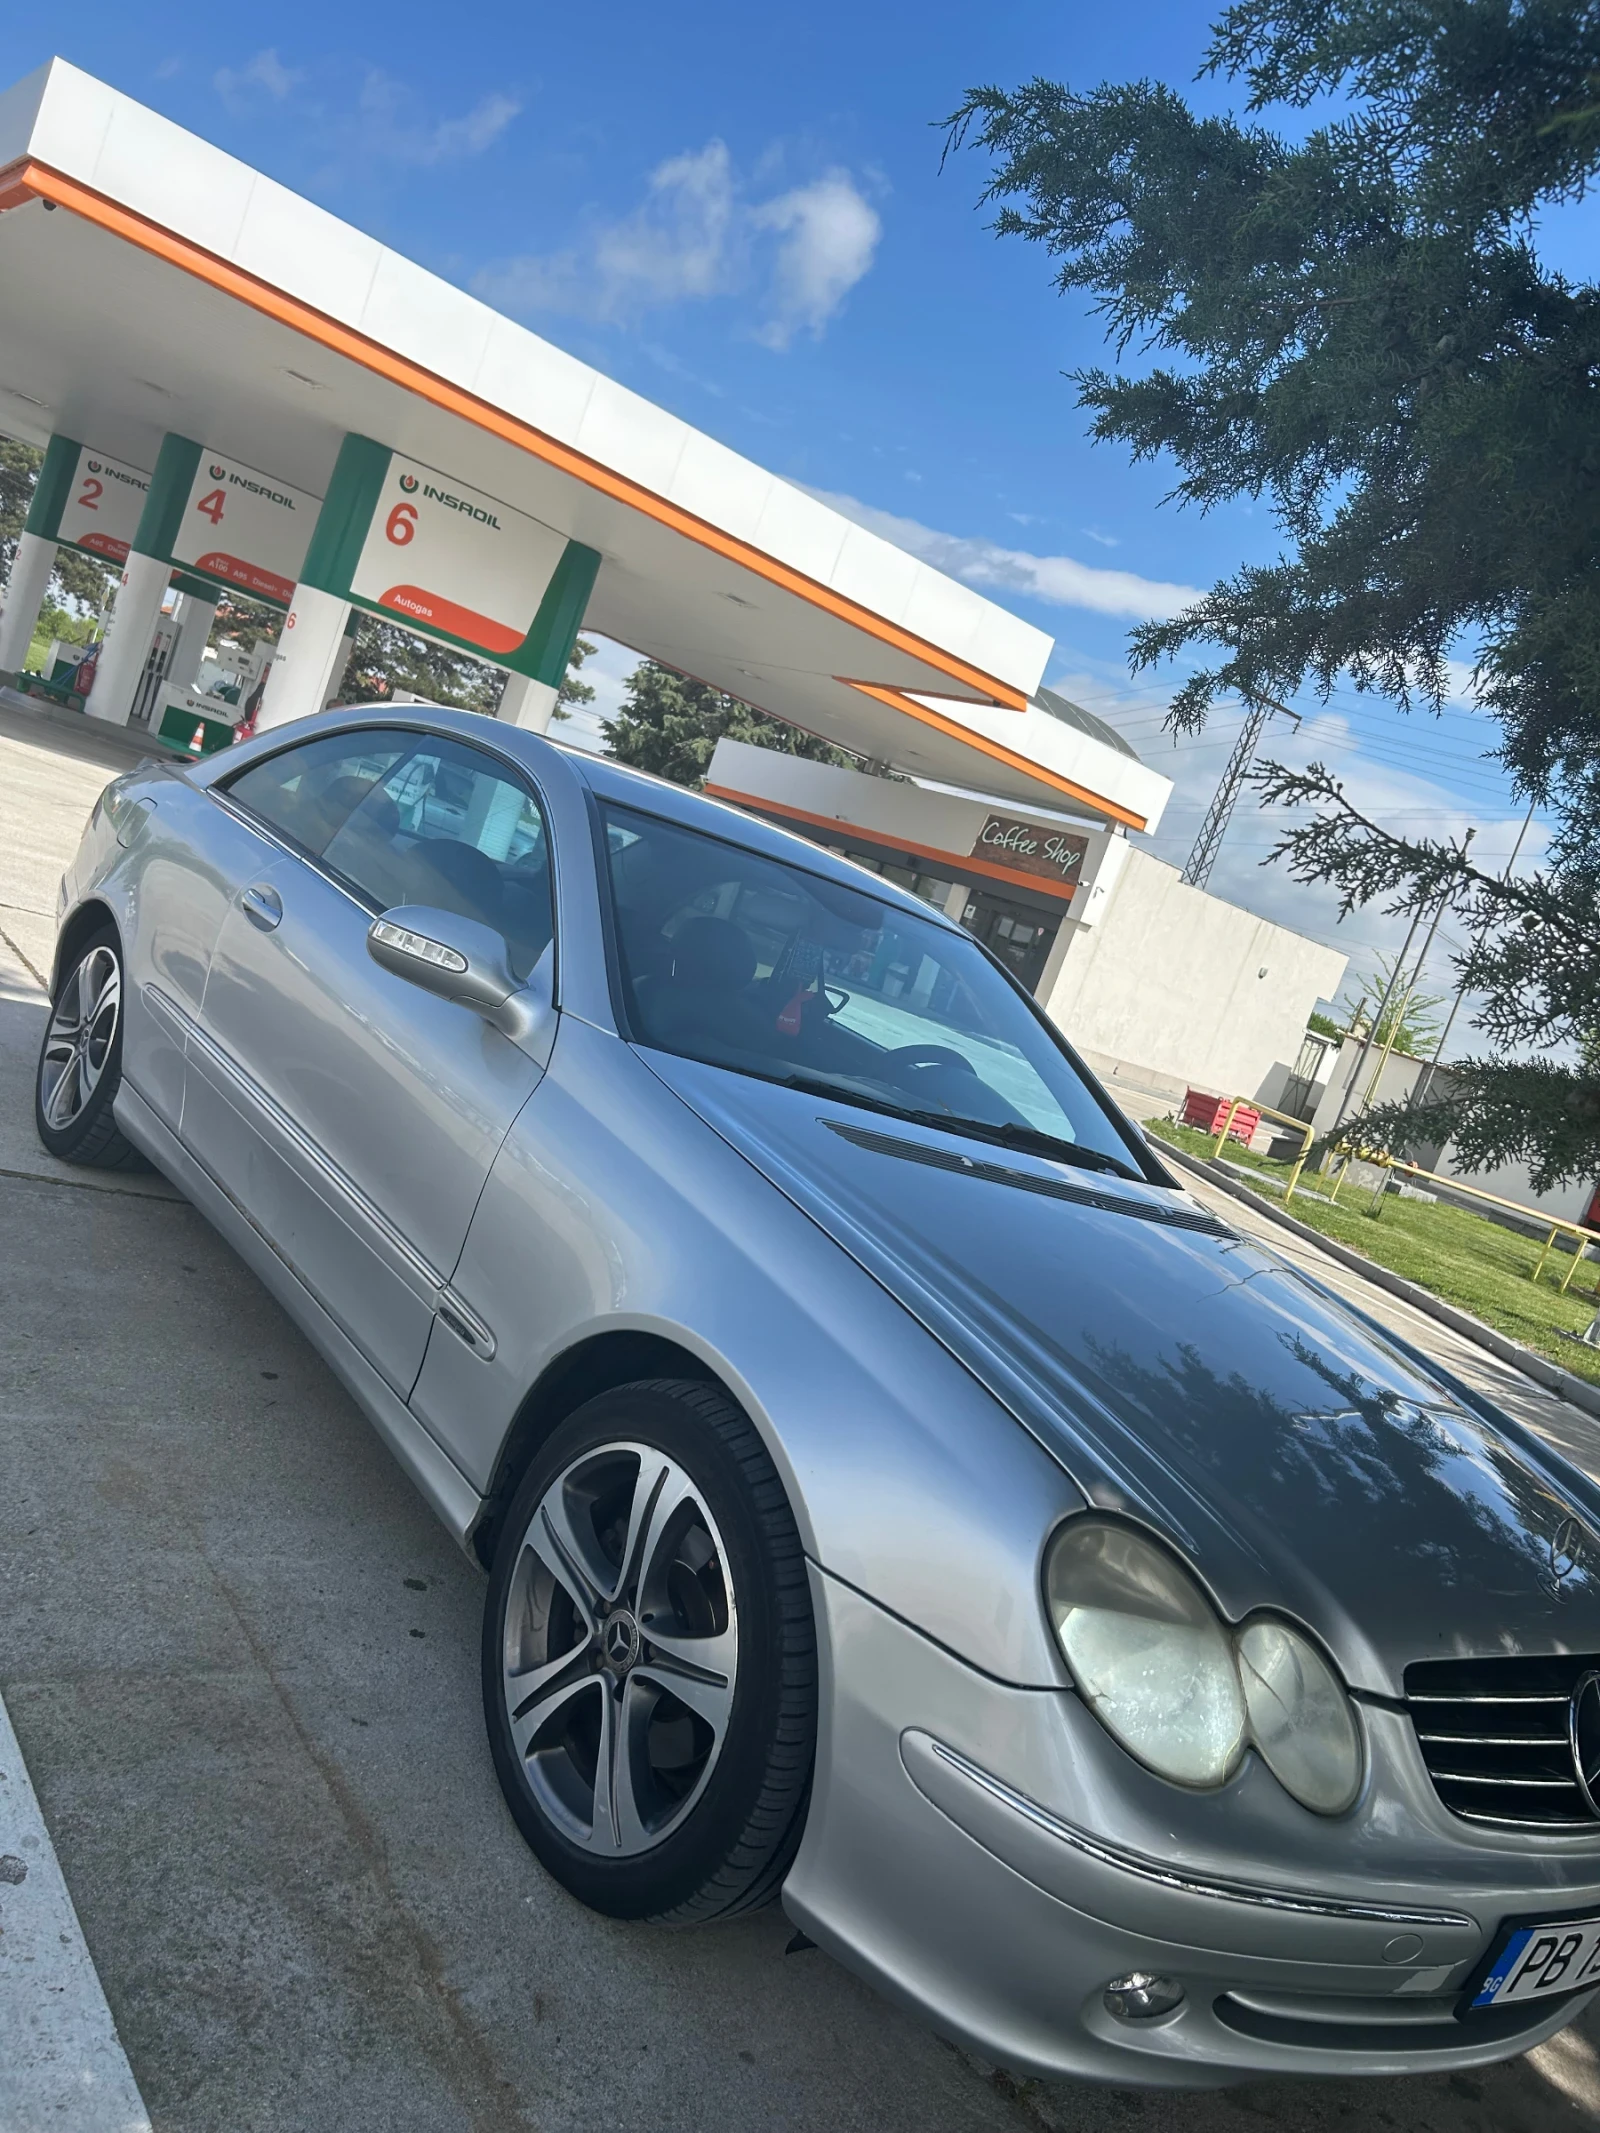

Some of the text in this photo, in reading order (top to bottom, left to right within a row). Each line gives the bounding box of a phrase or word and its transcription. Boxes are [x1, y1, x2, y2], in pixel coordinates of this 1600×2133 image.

[78, 478, 103, 510] 2
[105, 467, 150, 492] INSAO
[228, 473, 296, 510] INSAOIL
[197, 489, 227, 525] 4
[385, 502, 419, 546] 6
[422, 484, 501, 531] INSAOIL
[121, 572, 129, 587] 4
[208, 560, 228, 573] A100
[233, 570, 248, 580] A95
[287, 612, 297, 629] 6
[393, 594, 433, 617] Autogas
[981, 821, 1081, 876] Coffee Shop
[1506, 1932, 1583, 1993] PB
